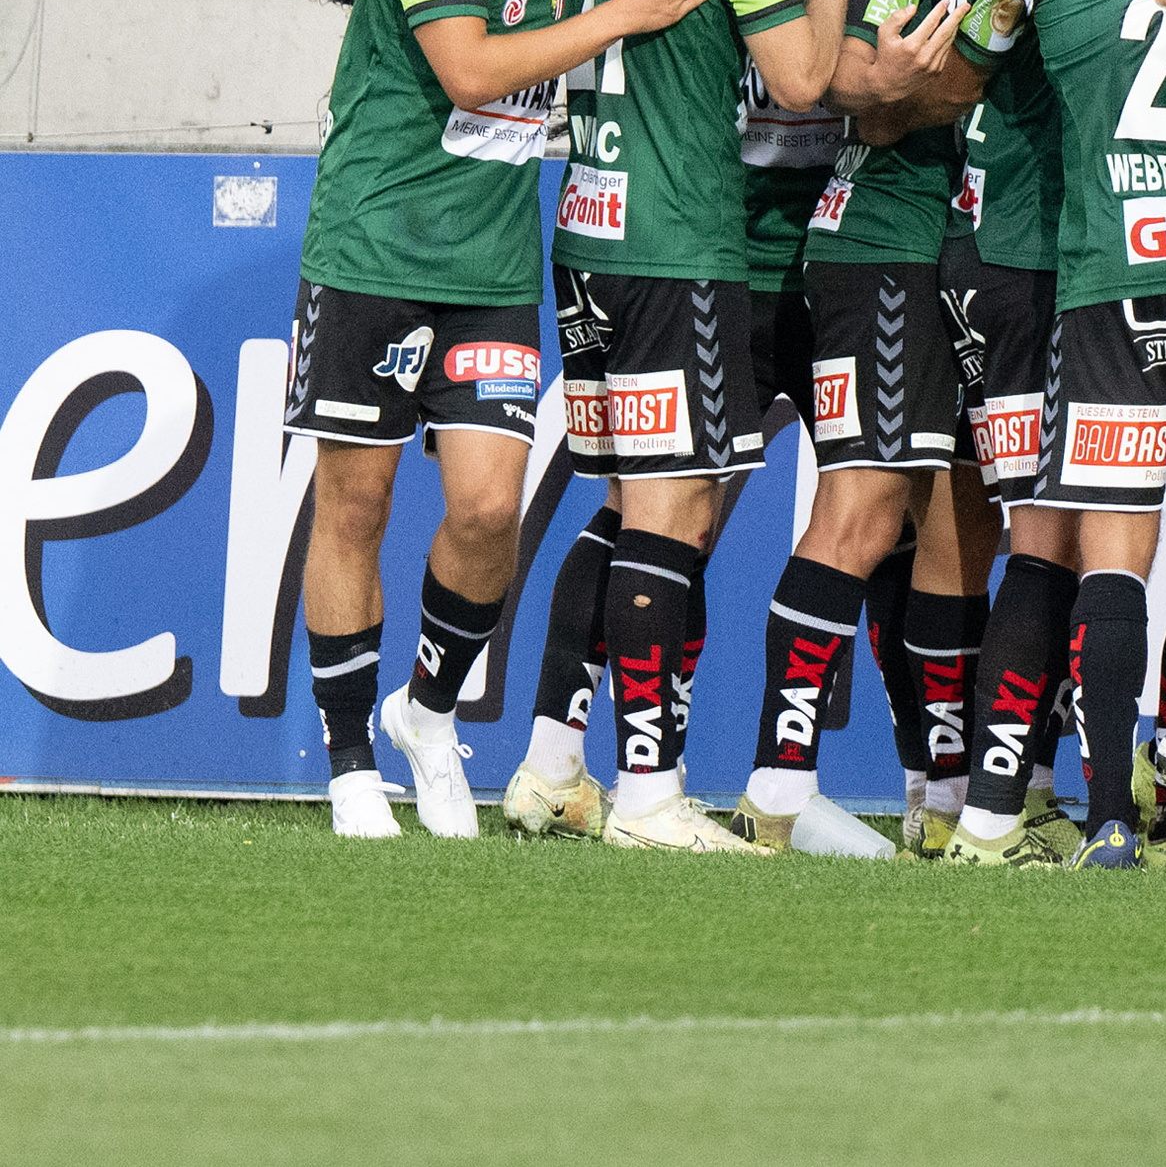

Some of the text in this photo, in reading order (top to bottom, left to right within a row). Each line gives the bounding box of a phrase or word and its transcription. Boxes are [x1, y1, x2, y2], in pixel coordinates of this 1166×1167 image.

[451, 120, 491, 138] MEINE
[776, 134, 811, 147] BESTE
[559, 184, 621, 228] Granit
[455, 349, 541, 382] FUSS
[1116, 406, 1124, 417] &
[1127, 407, 1160, 419] STEIN
[632, 437, 676, 451] Polling
[1003, 460, 1039, 473] Polling
[619, 644, 662, 770] DAXL
[776, 636, 842, 747] DAXL
[923, 654, 966, 762] DAXL
[983, 669, 1048, 777] DAXL
